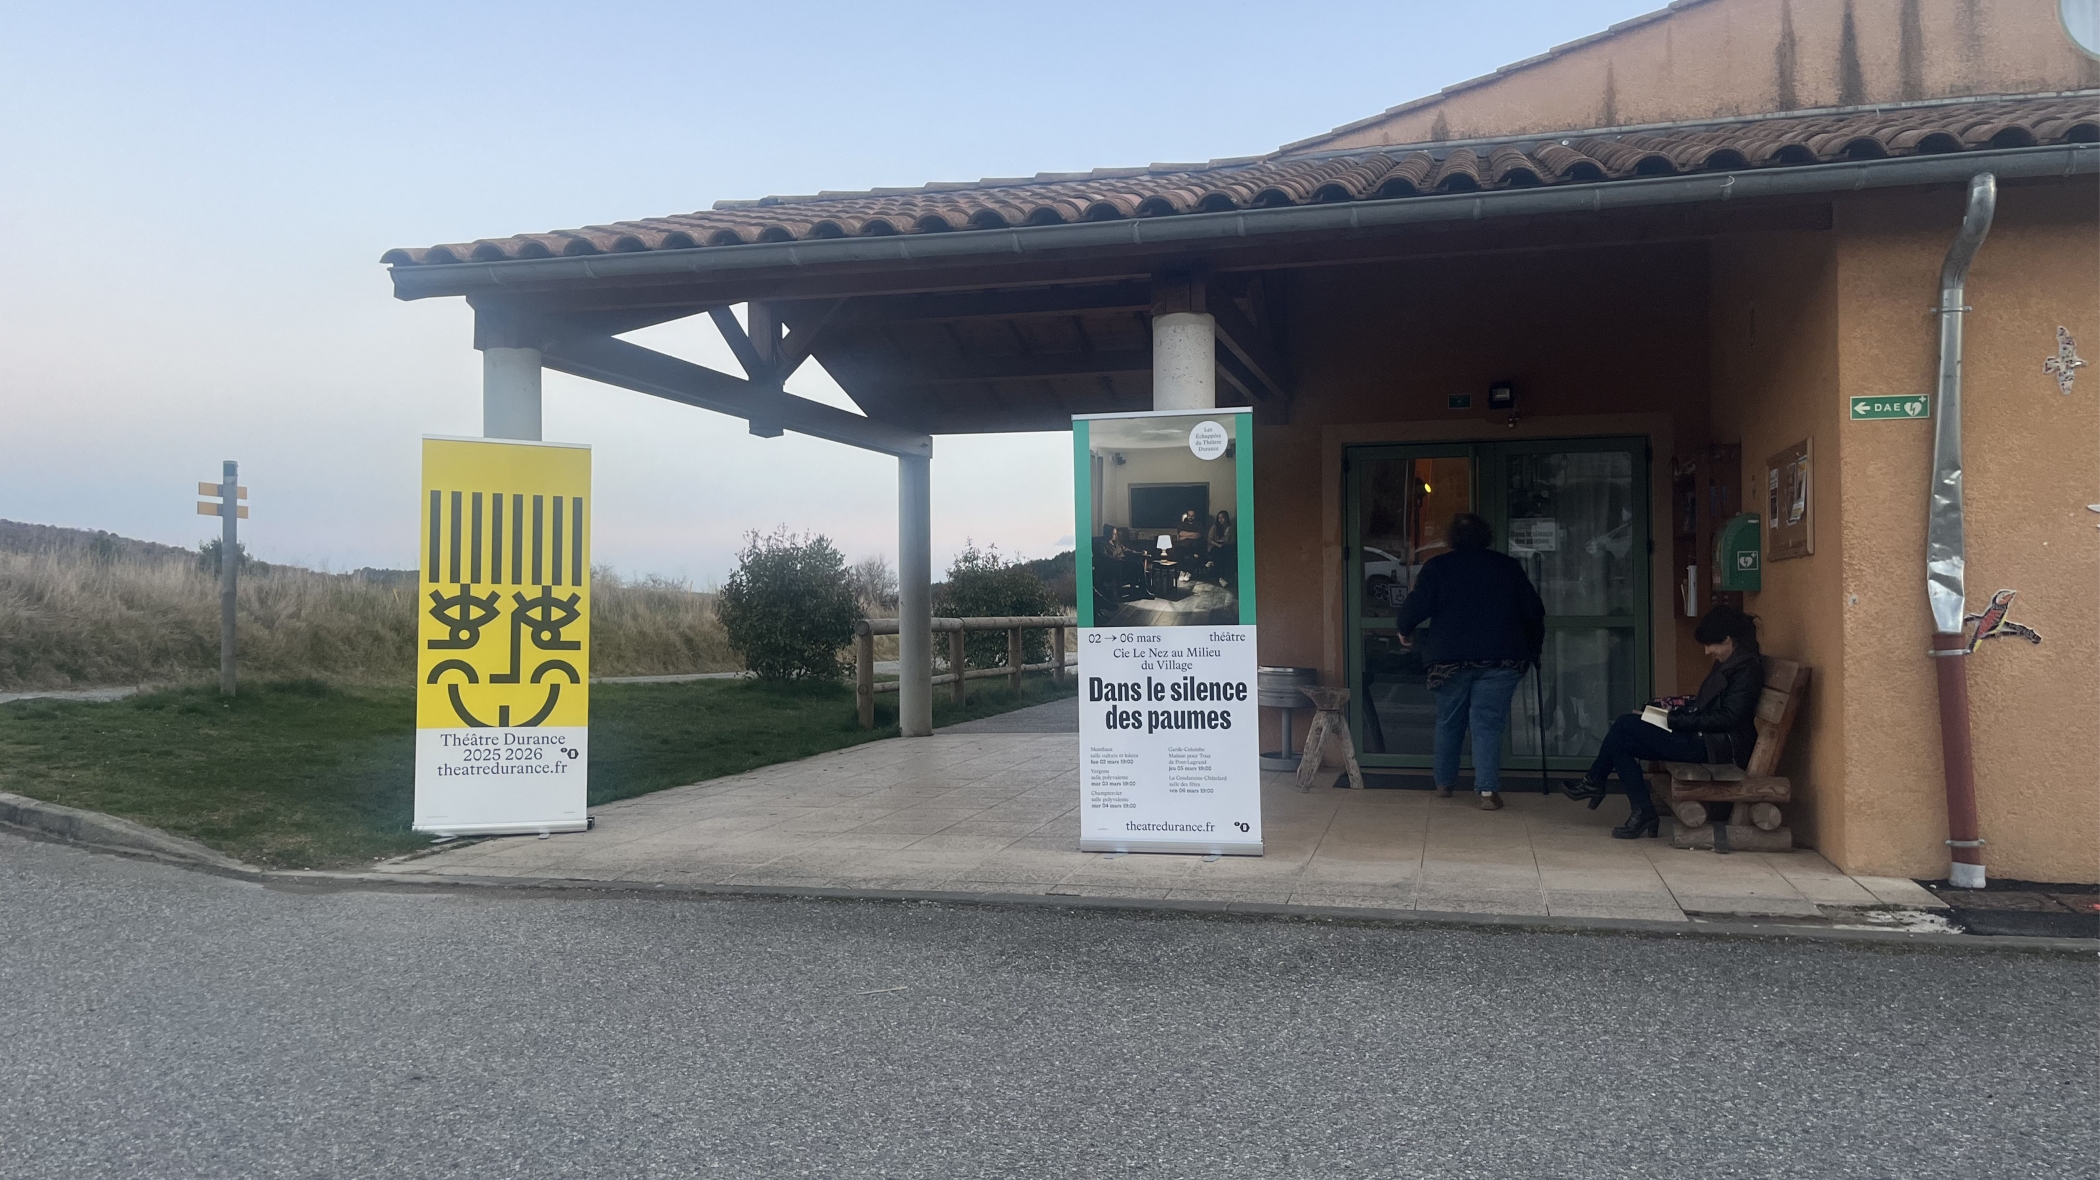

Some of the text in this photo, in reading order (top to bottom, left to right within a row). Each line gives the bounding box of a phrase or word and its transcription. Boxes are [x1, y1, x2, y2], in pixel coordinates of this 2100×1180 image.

[1875, 403, 1900, 411] DAE
[1089, 632, 1246, 643] 02 06 mars théâtre
[1113, 648, 1130, 658] Cie
[1133, 648, 1145, 658] Le
[1149, 648, 1168, 658] Nez
[1186, 648, 1221, 657] Milieu
[1141, 660, 1192, 672] du Village
[1089, 676, 1247, 701] Dans le silence
[1106, 705, 1231, 734] des paumes
[440, 733, 565, 747] Théâtre Durance
[463, 748, 542, 762] 2025 2026
[437, 760, 567, 776] theatredurance.fr
[1126, 821, 1215, 832] theatredurance.fr
